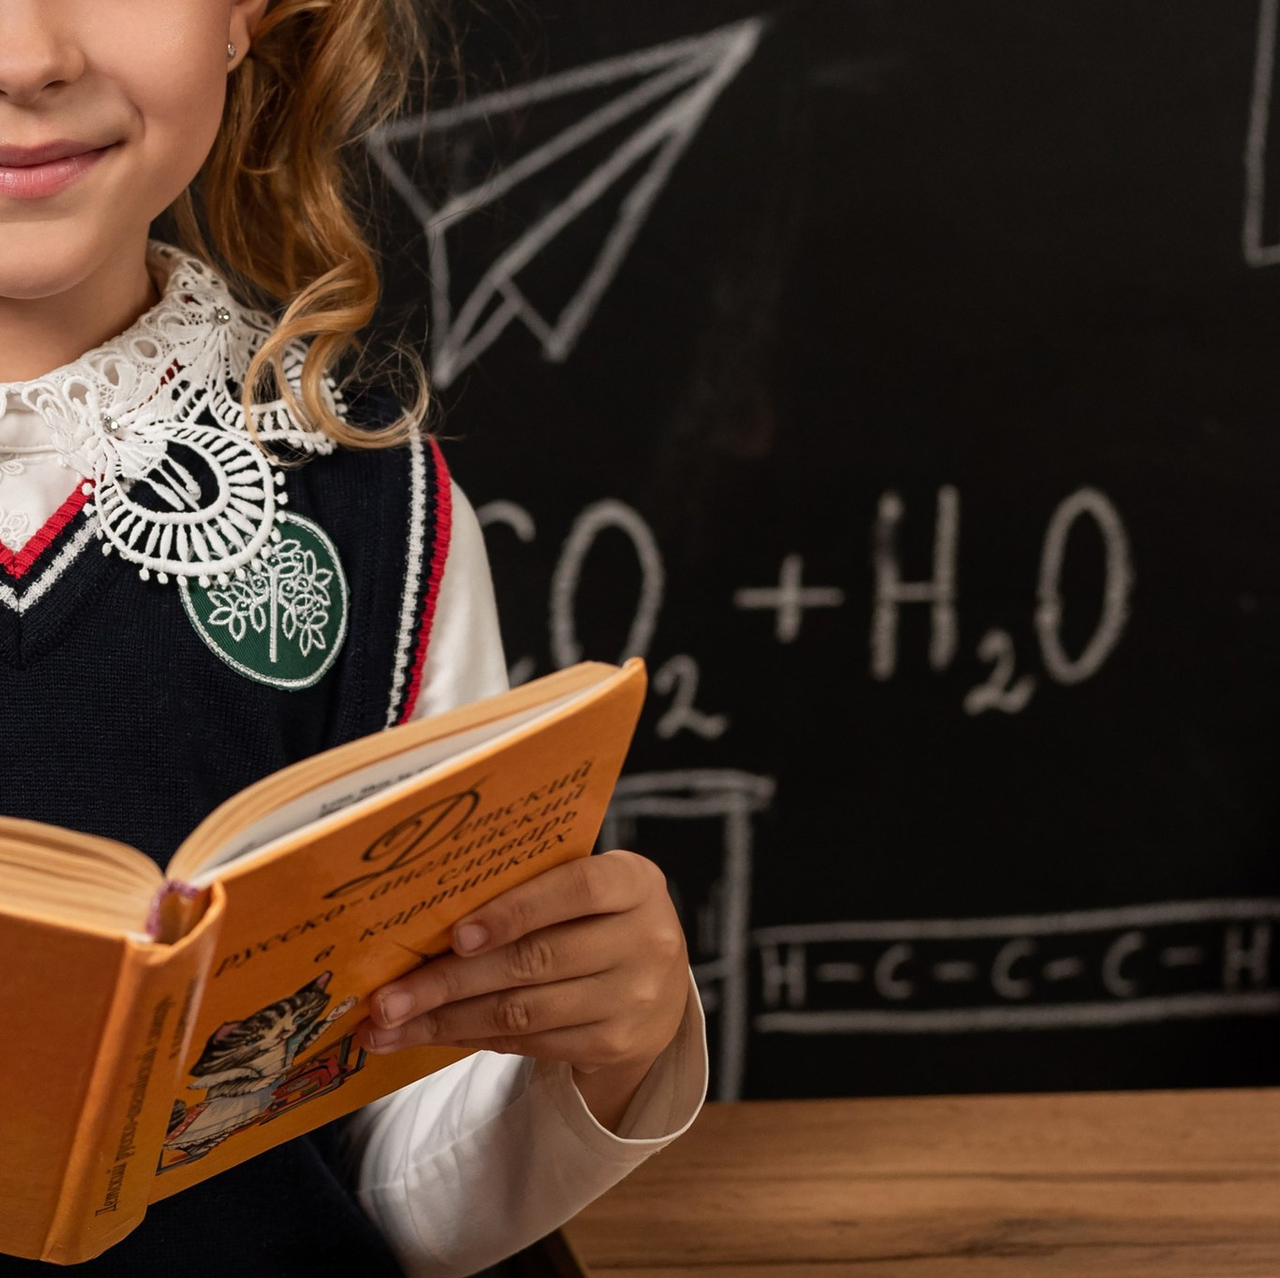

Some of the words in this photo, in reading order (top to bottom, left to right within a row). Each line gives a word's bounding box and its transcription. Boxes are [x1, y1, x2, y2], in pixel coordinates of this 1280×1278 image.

[214, 782, 588, 977] русско-английский
[322, 758, 595, 899] Детский
[358, 825, 575, 943] картинках
[436, 808, 578, 887] словарь
